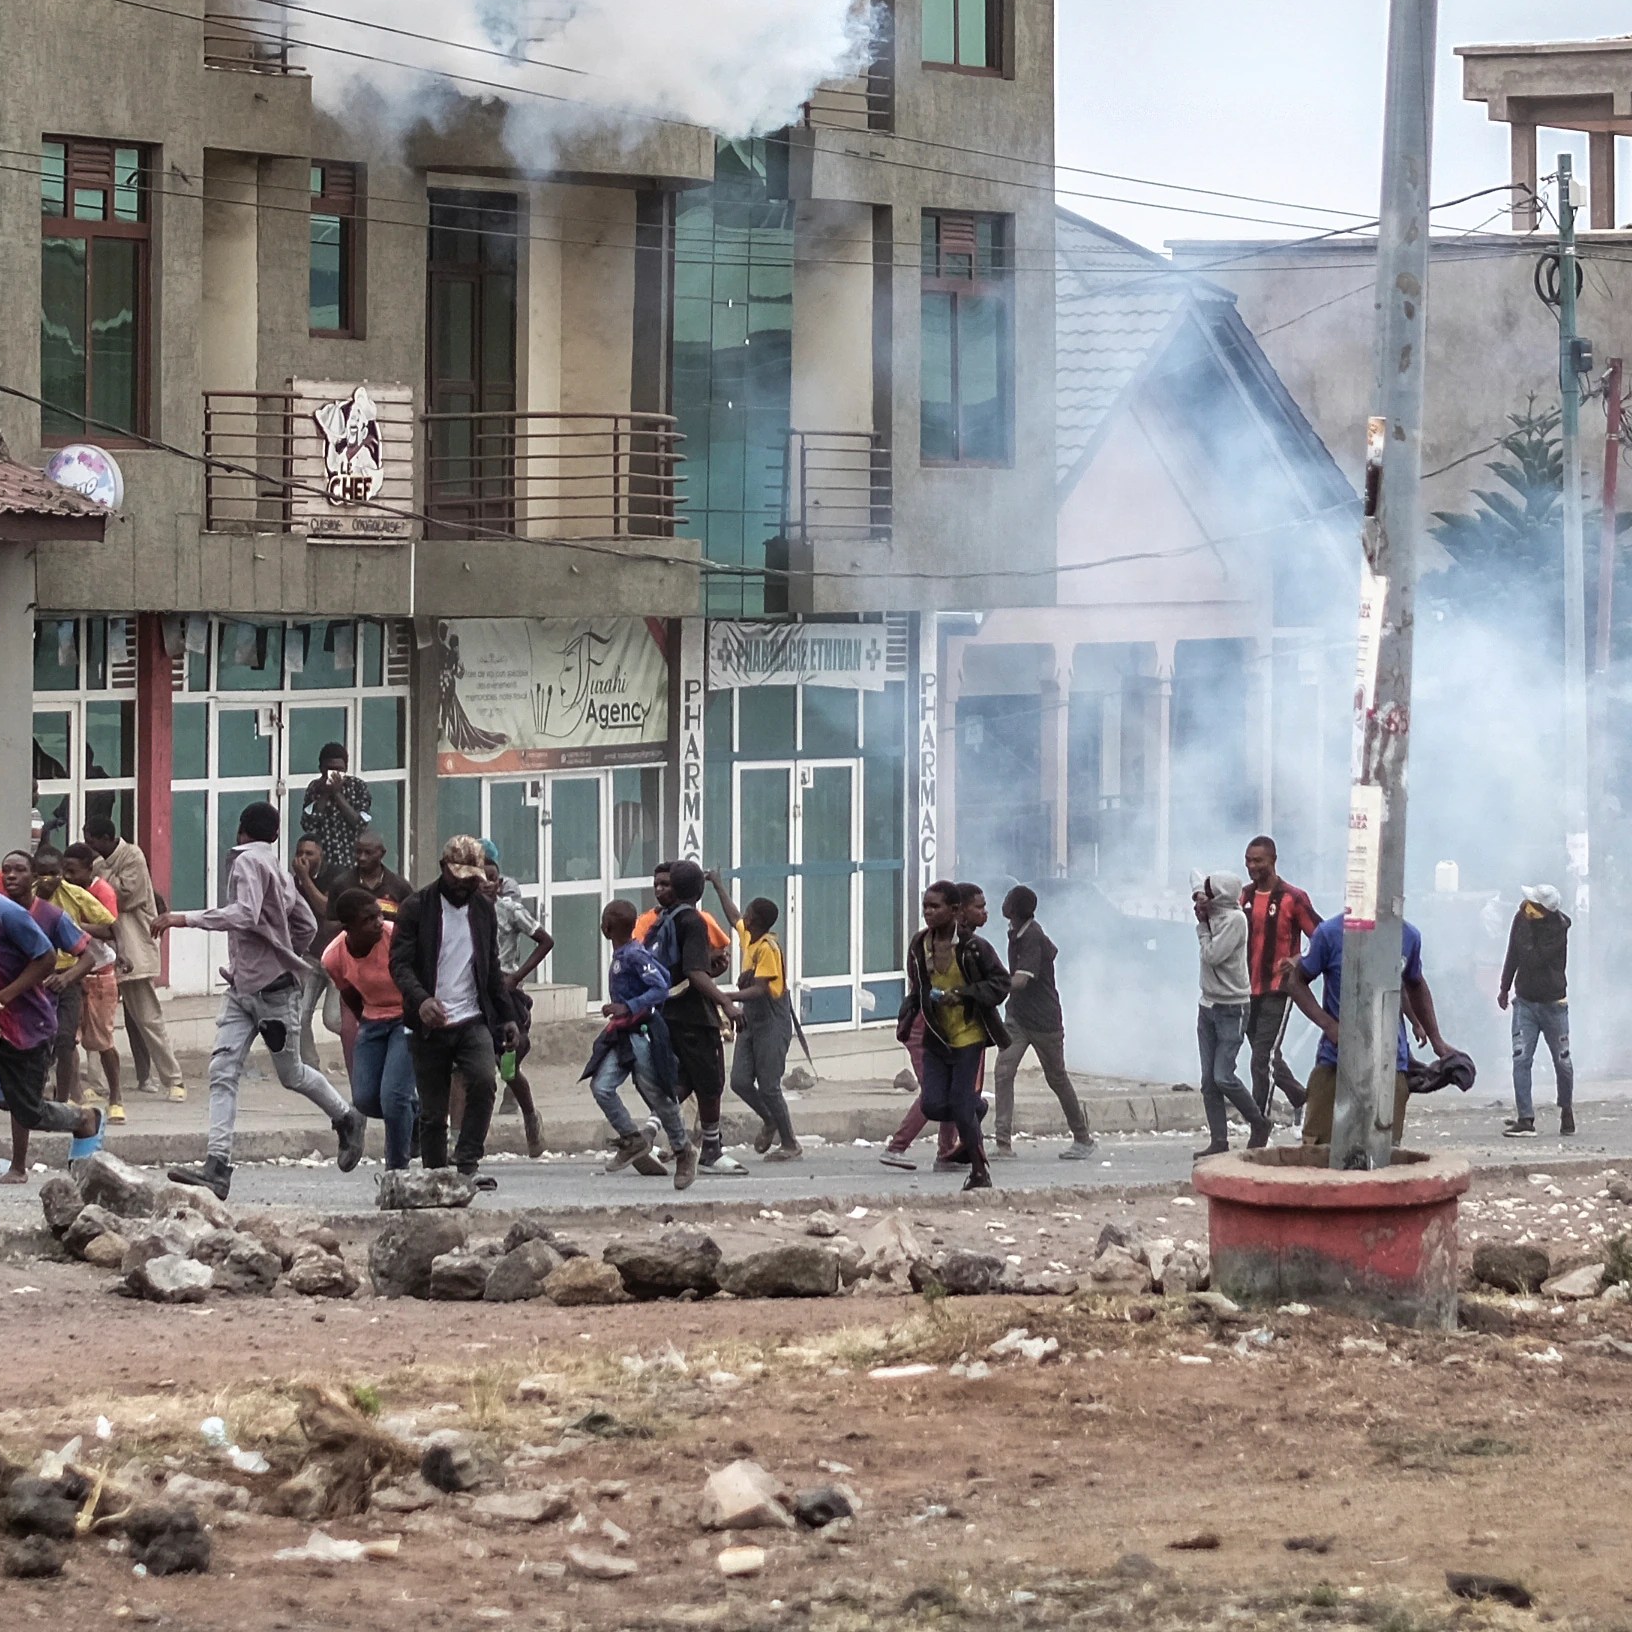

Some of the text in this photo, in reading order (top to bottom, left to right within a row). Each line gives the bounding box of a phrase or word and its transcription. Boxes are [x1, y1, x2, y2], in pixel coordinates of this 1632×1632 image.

[340, 462, 353, 475] LE
[329, 476, 373, 501] CHEF
[585, 696, 652, 742] Agency
